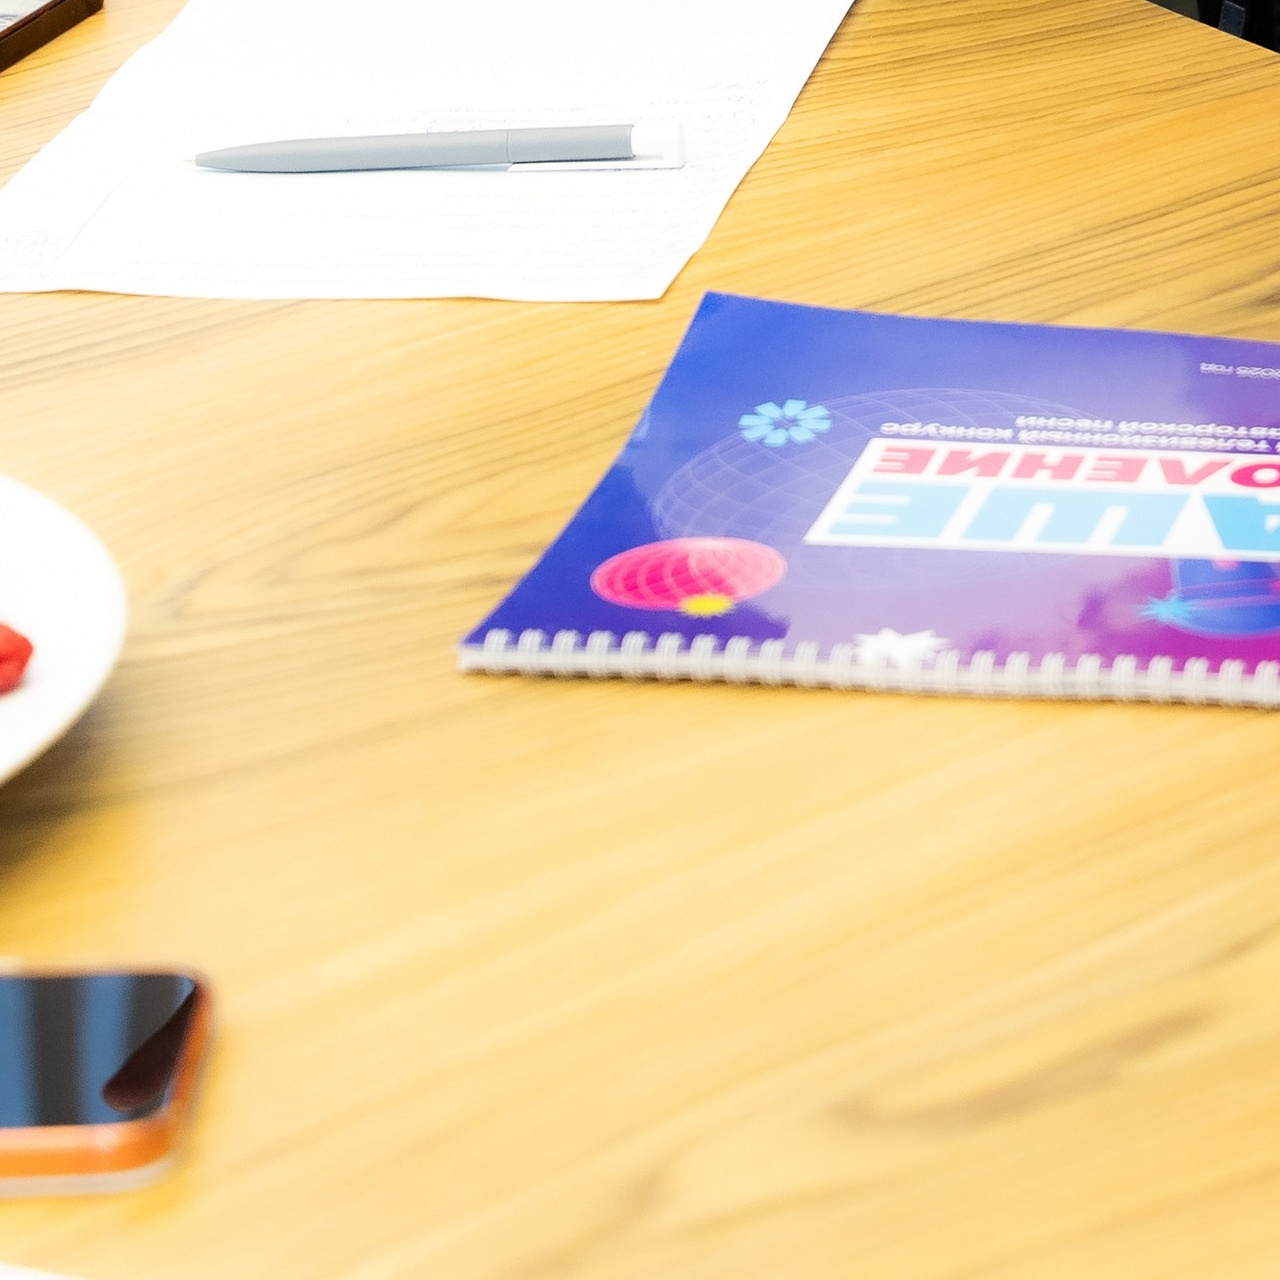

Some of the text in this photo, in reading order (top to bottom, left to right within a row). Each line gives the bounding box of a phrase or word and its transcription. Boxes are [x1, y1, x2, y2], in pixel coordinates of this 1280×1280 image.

[1200, 362, 1234, 376] год
[880, 421, 1015, 440] конкурс
[1014, 414, 1114, 432] песни
[1018, 428, 1270, 452] телевизионный
